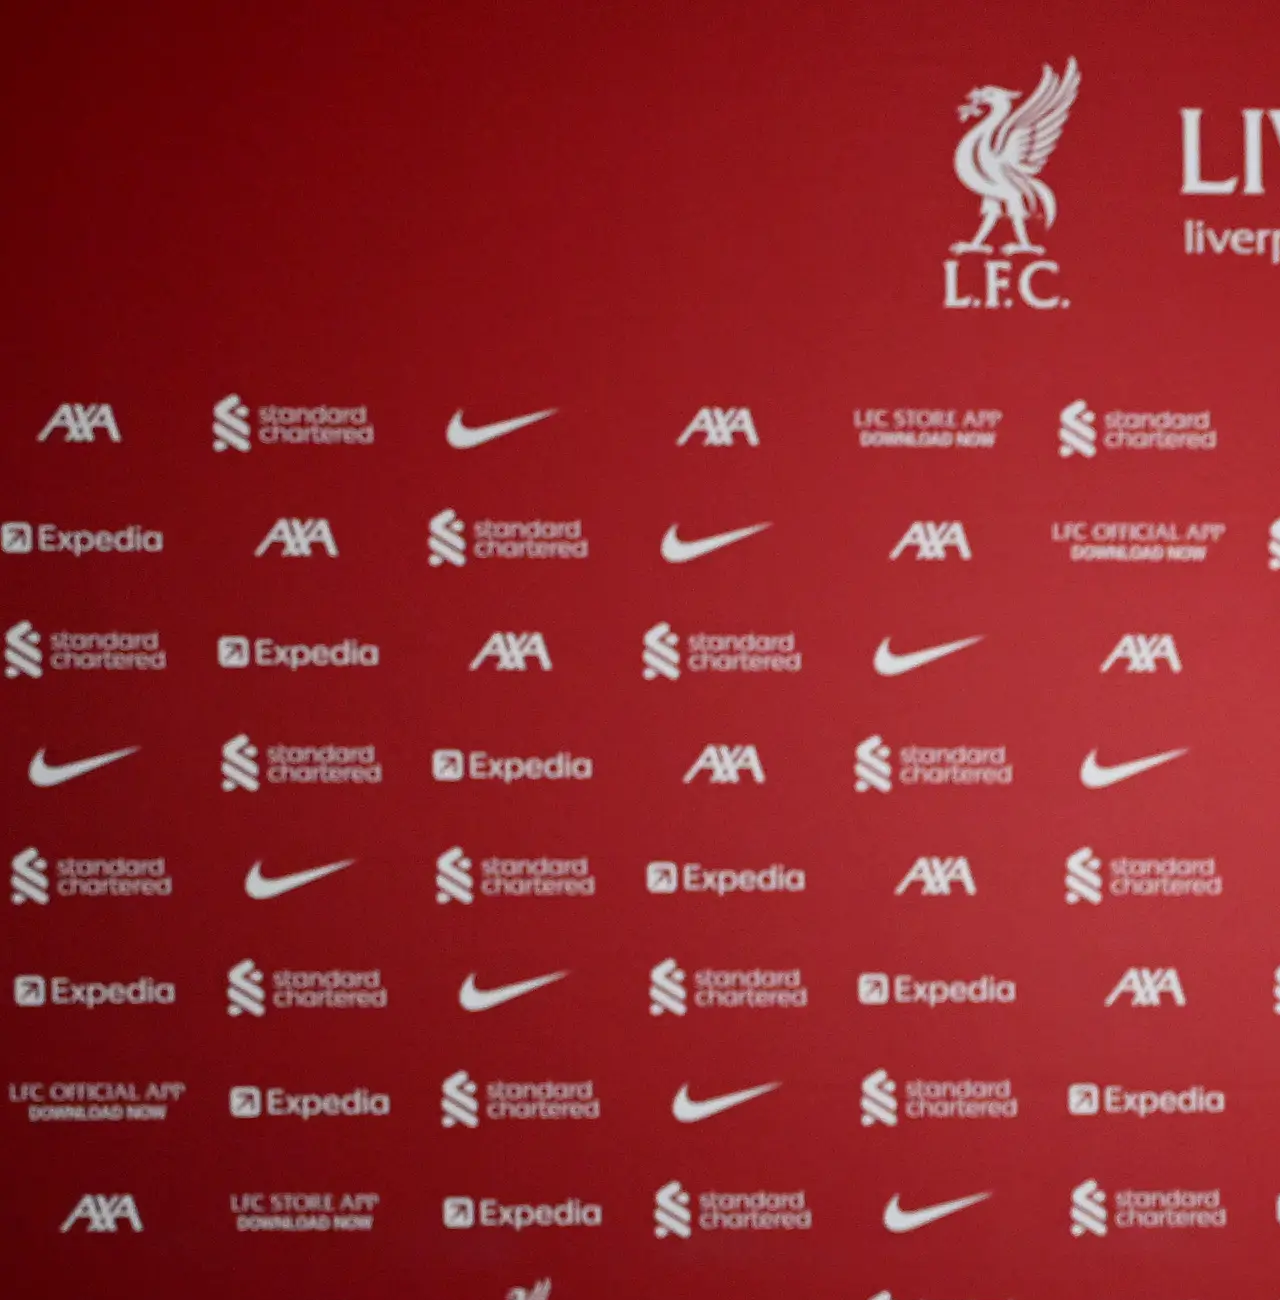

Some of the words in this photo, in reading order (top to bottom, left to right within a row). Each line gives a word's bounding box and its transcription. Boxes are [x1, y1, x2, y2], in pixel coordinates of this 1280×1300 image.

[944, 259, 1070, 309] L.F.C.
[38, 403, 121, 442] AXA
[258, 405, 366, 426] standard
[677, 407, 759, 446] AXA
[962, 409, 1003, 428] APP
[258, 424, 374, 445] chartered
[860, 431, 952, 447] DOWNLOAD
[956, 431, 996, 447] NOW
[38, 524, 163, 557] Expedia
[255, 518, 339, 557] AXA
[1185, 523, 1226, 542] APP
[1071, 545, 1162, 561] DOWNLOAD
[1166, 545, 1207, 561] NOW
[254, 638, 379, 671] Expedia
[1101, 634, 1182, 672] AXA
[469, 751, 593, 784] Expedia
[56, 857, 164, 878] standard
[683, 863, 806, 896] Expedia
[57, 876, 172, 896] chartered
[51, 977, 176, 1009] Expedia
[695, 968, 800, 989] standard
[1105, 968, 1186, 1007] AXA
[694, 987, 808, 1008] chartered
[266, 1088, 390, 1120] Expedia
[1104, 1085, 1225, 1117] Expedia
[61, 1194, 143, 1233] AXA
[479, 1198, 602, 1231] Expedia
[1115, 1188, 1219, 1210] standard
[1114, 1208, 1227, 1228] chartered
